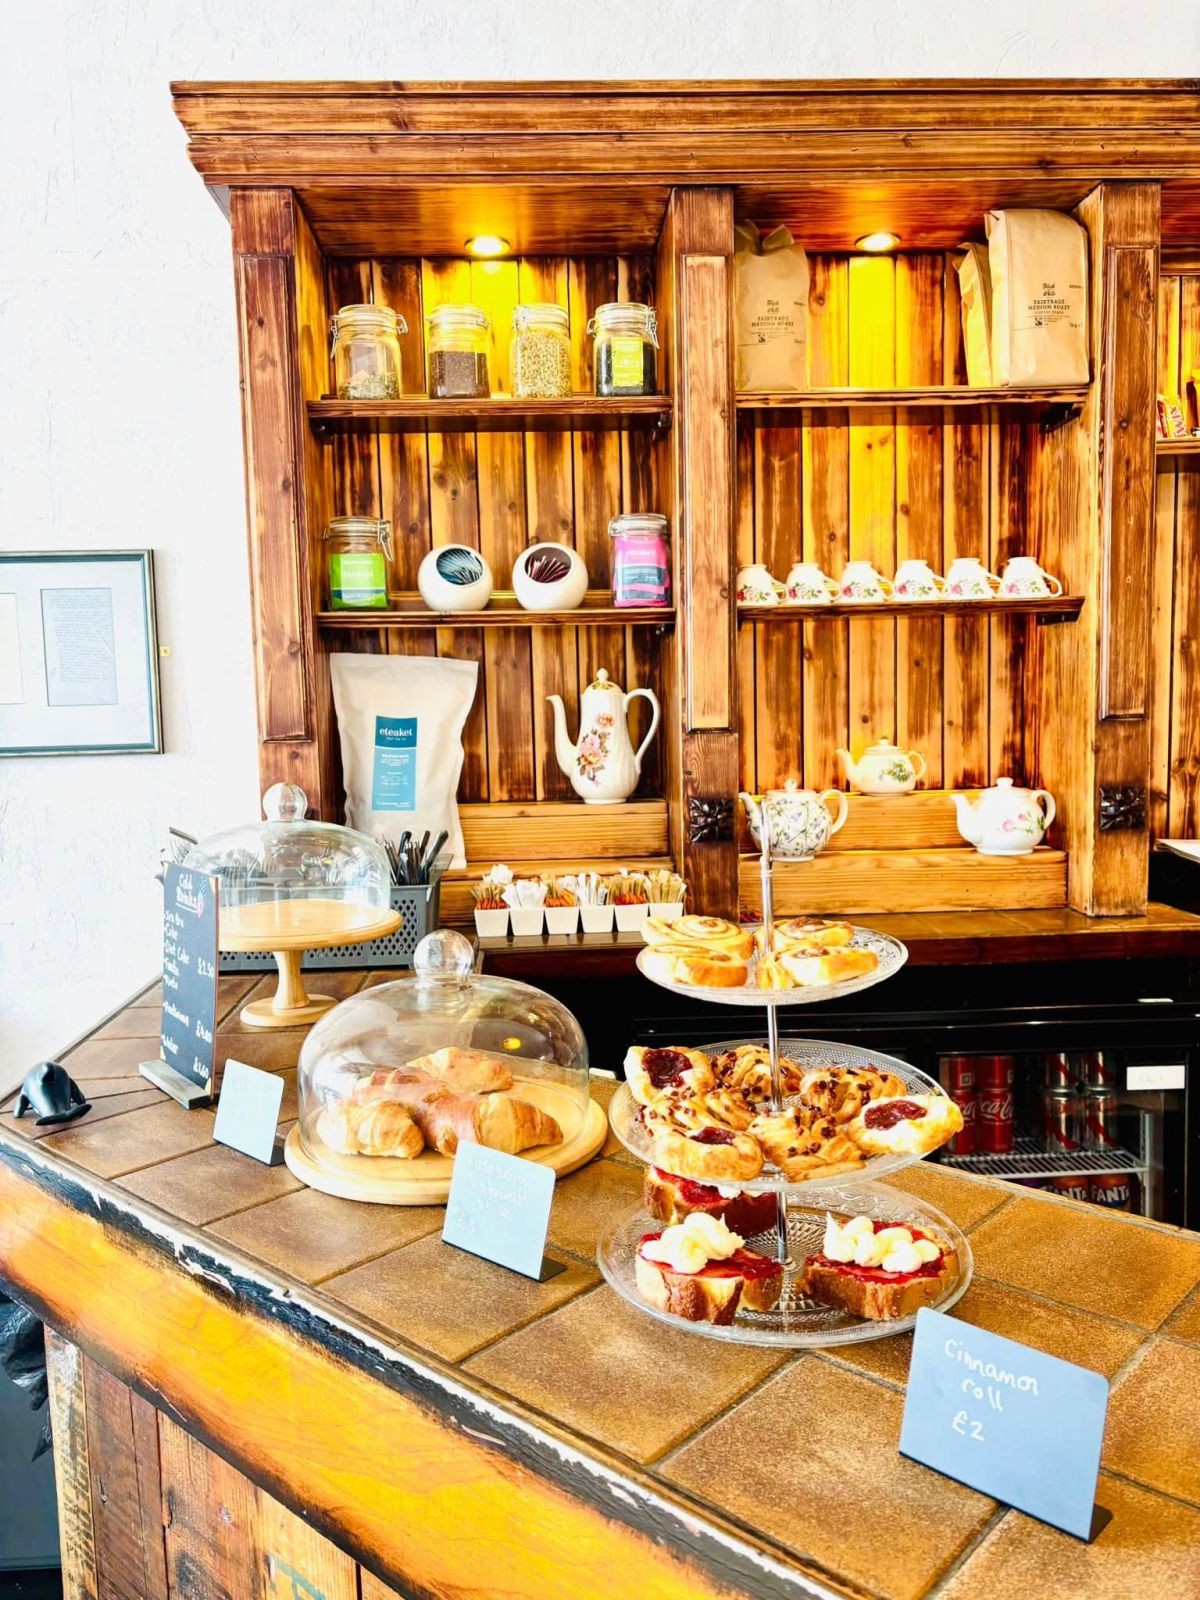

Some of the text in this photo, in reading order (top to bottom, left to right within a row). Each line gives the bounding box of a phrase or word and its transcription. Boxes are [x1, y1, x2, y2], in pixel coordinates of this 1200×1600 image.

[944, 1339, 1040, 1396] Cinnamon
[961, 1378, 1004, 1413] roll
[951, 1410, 985, 1441] £2
